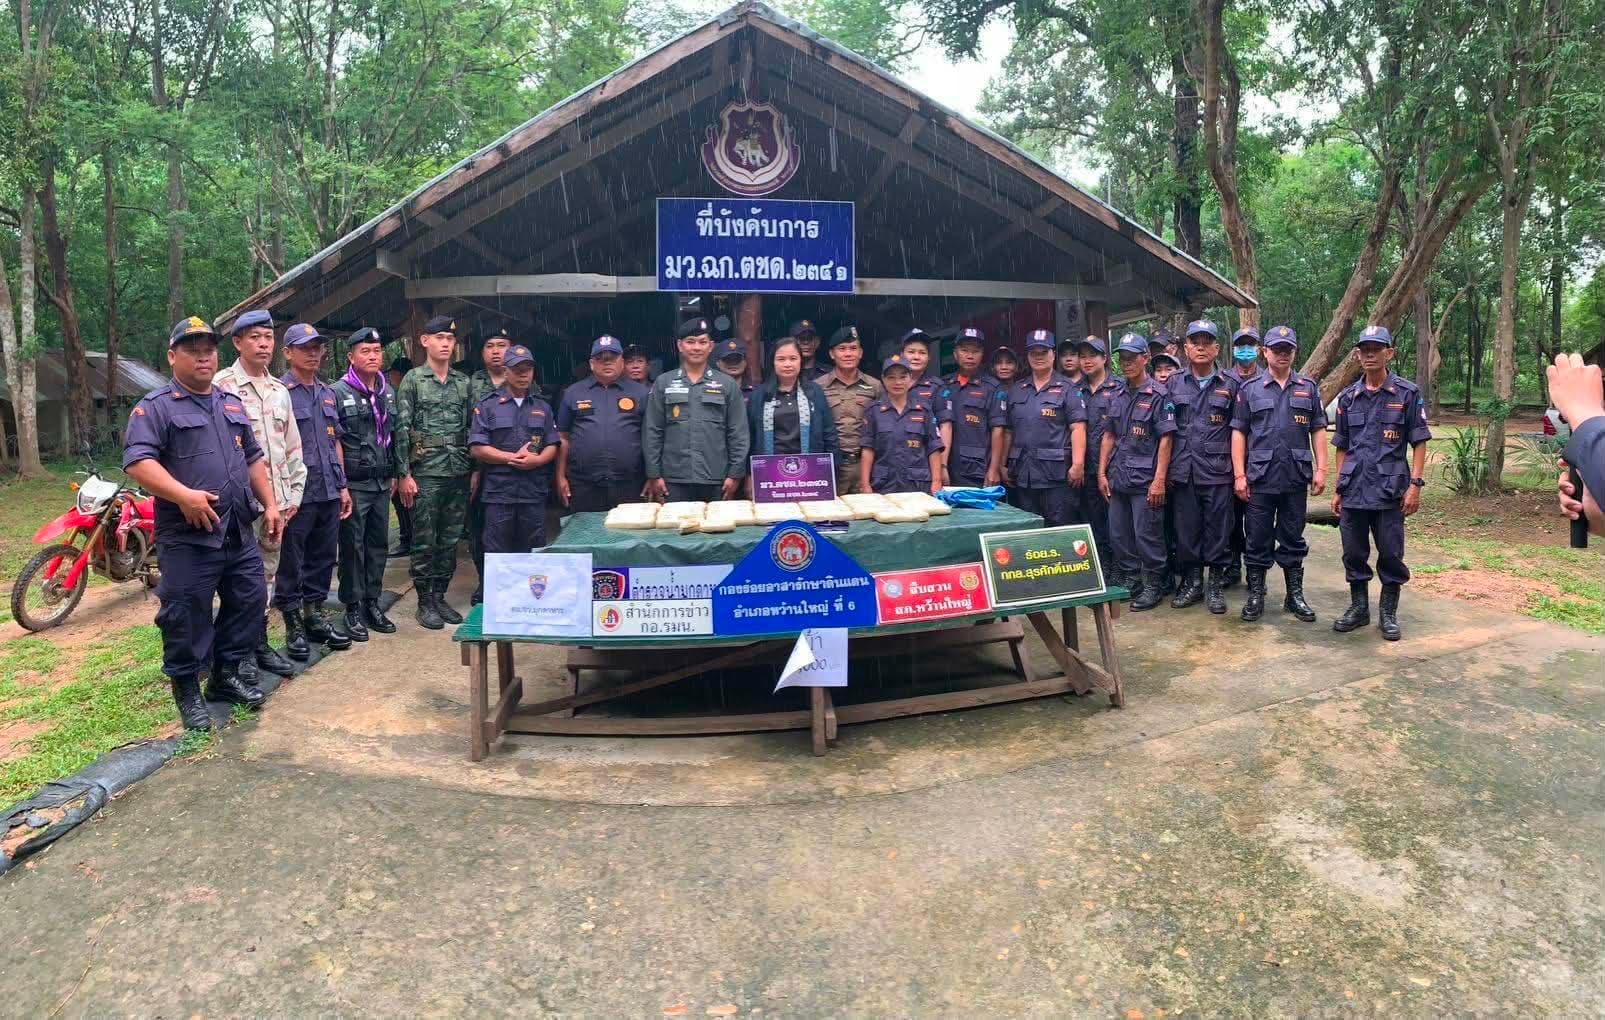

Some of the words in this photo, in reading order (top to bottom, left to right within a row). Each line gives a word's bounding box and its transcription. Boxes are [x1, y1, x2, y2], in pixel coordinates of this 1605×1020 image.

[696, 202, 819, 239] ที่บังคับการ
[719, 575, 870, 596] กองร้อยอาสารักษาดินแดน
[626, 603, 709, 619] สำนักการข่าว
[733, 601, 829, 618] อำเภอหว้านใหญ่
[833, 595, 844, 612] ที่
[847, 601, 856, 611] 6
[640, 622, 696, 633] กอ.รมน.
